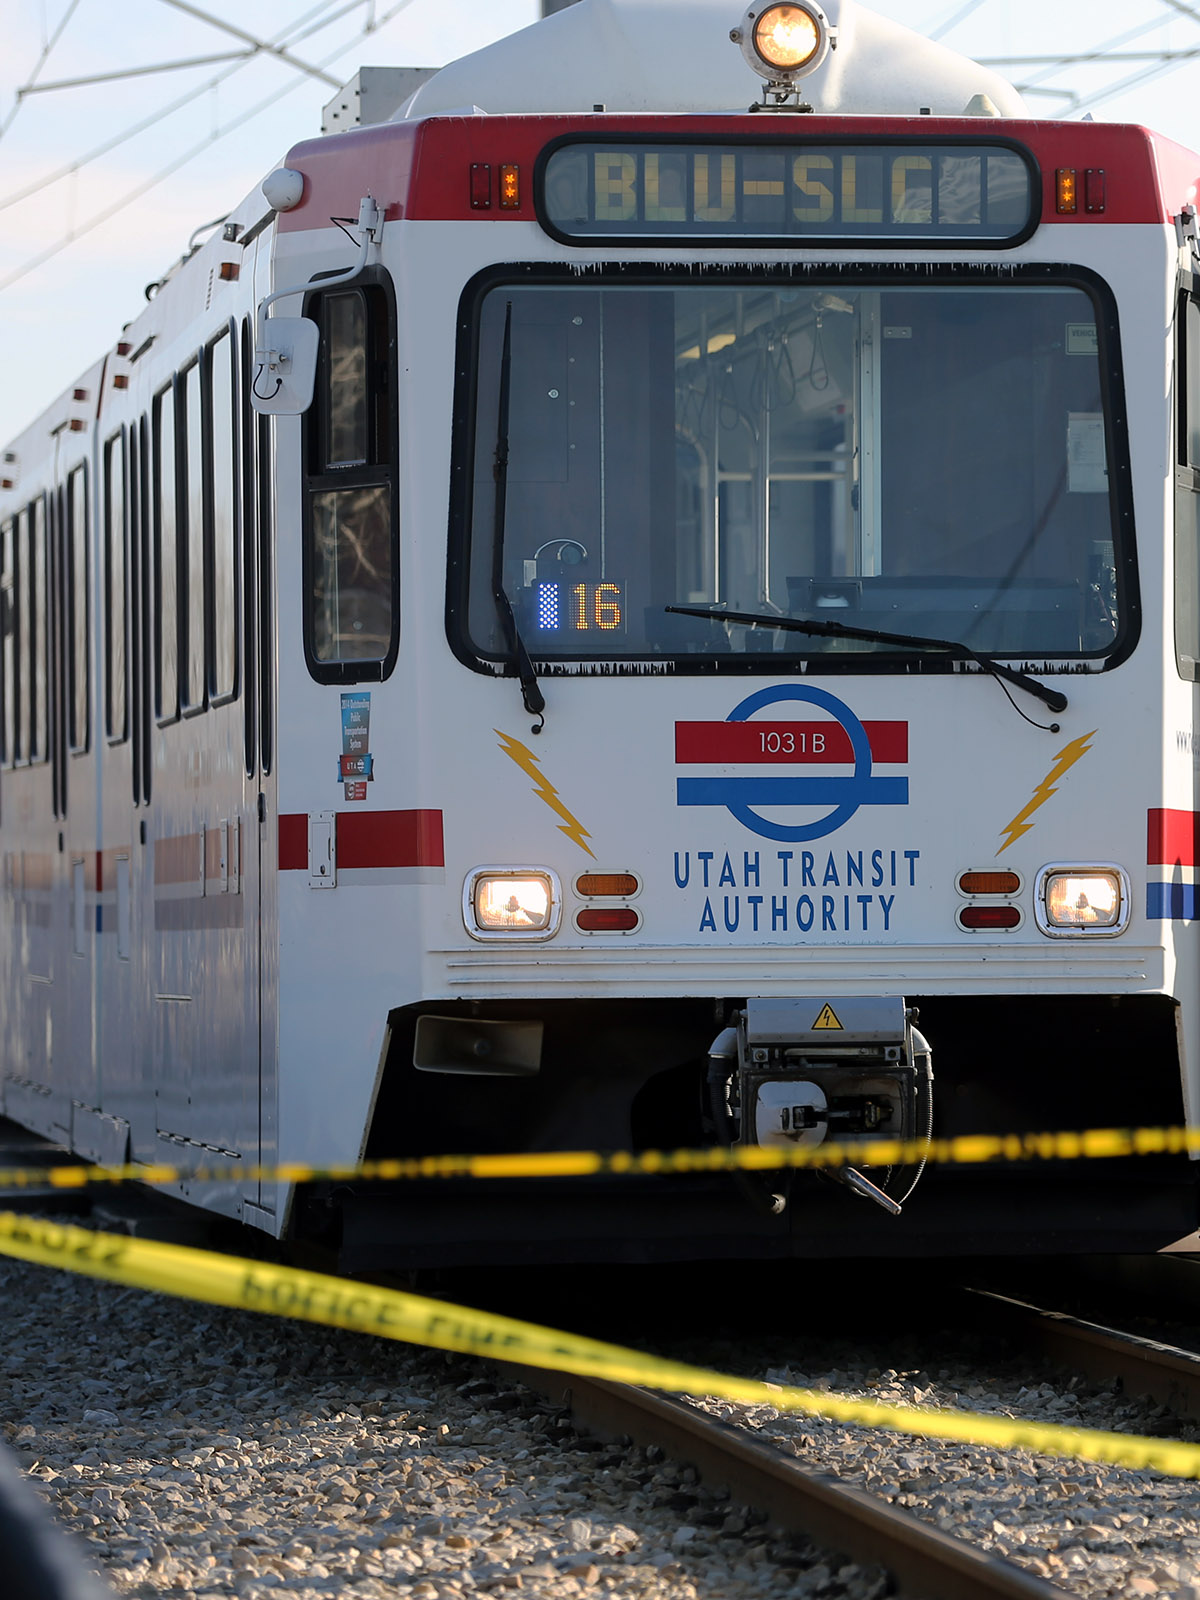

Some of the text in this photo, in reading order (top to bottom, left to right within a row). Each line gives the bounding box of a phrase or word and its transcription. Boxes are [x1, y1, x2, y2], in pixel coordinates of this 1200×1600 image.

[594, 152, 933, 224] BLU-SLC
[573, 583, 621, 630] 16
[759, 732, 826, 754] 1031B
[673, 849, 920, 889] UTAH TRANSIT
[698, 894, 896, 932] AUTHORITY
